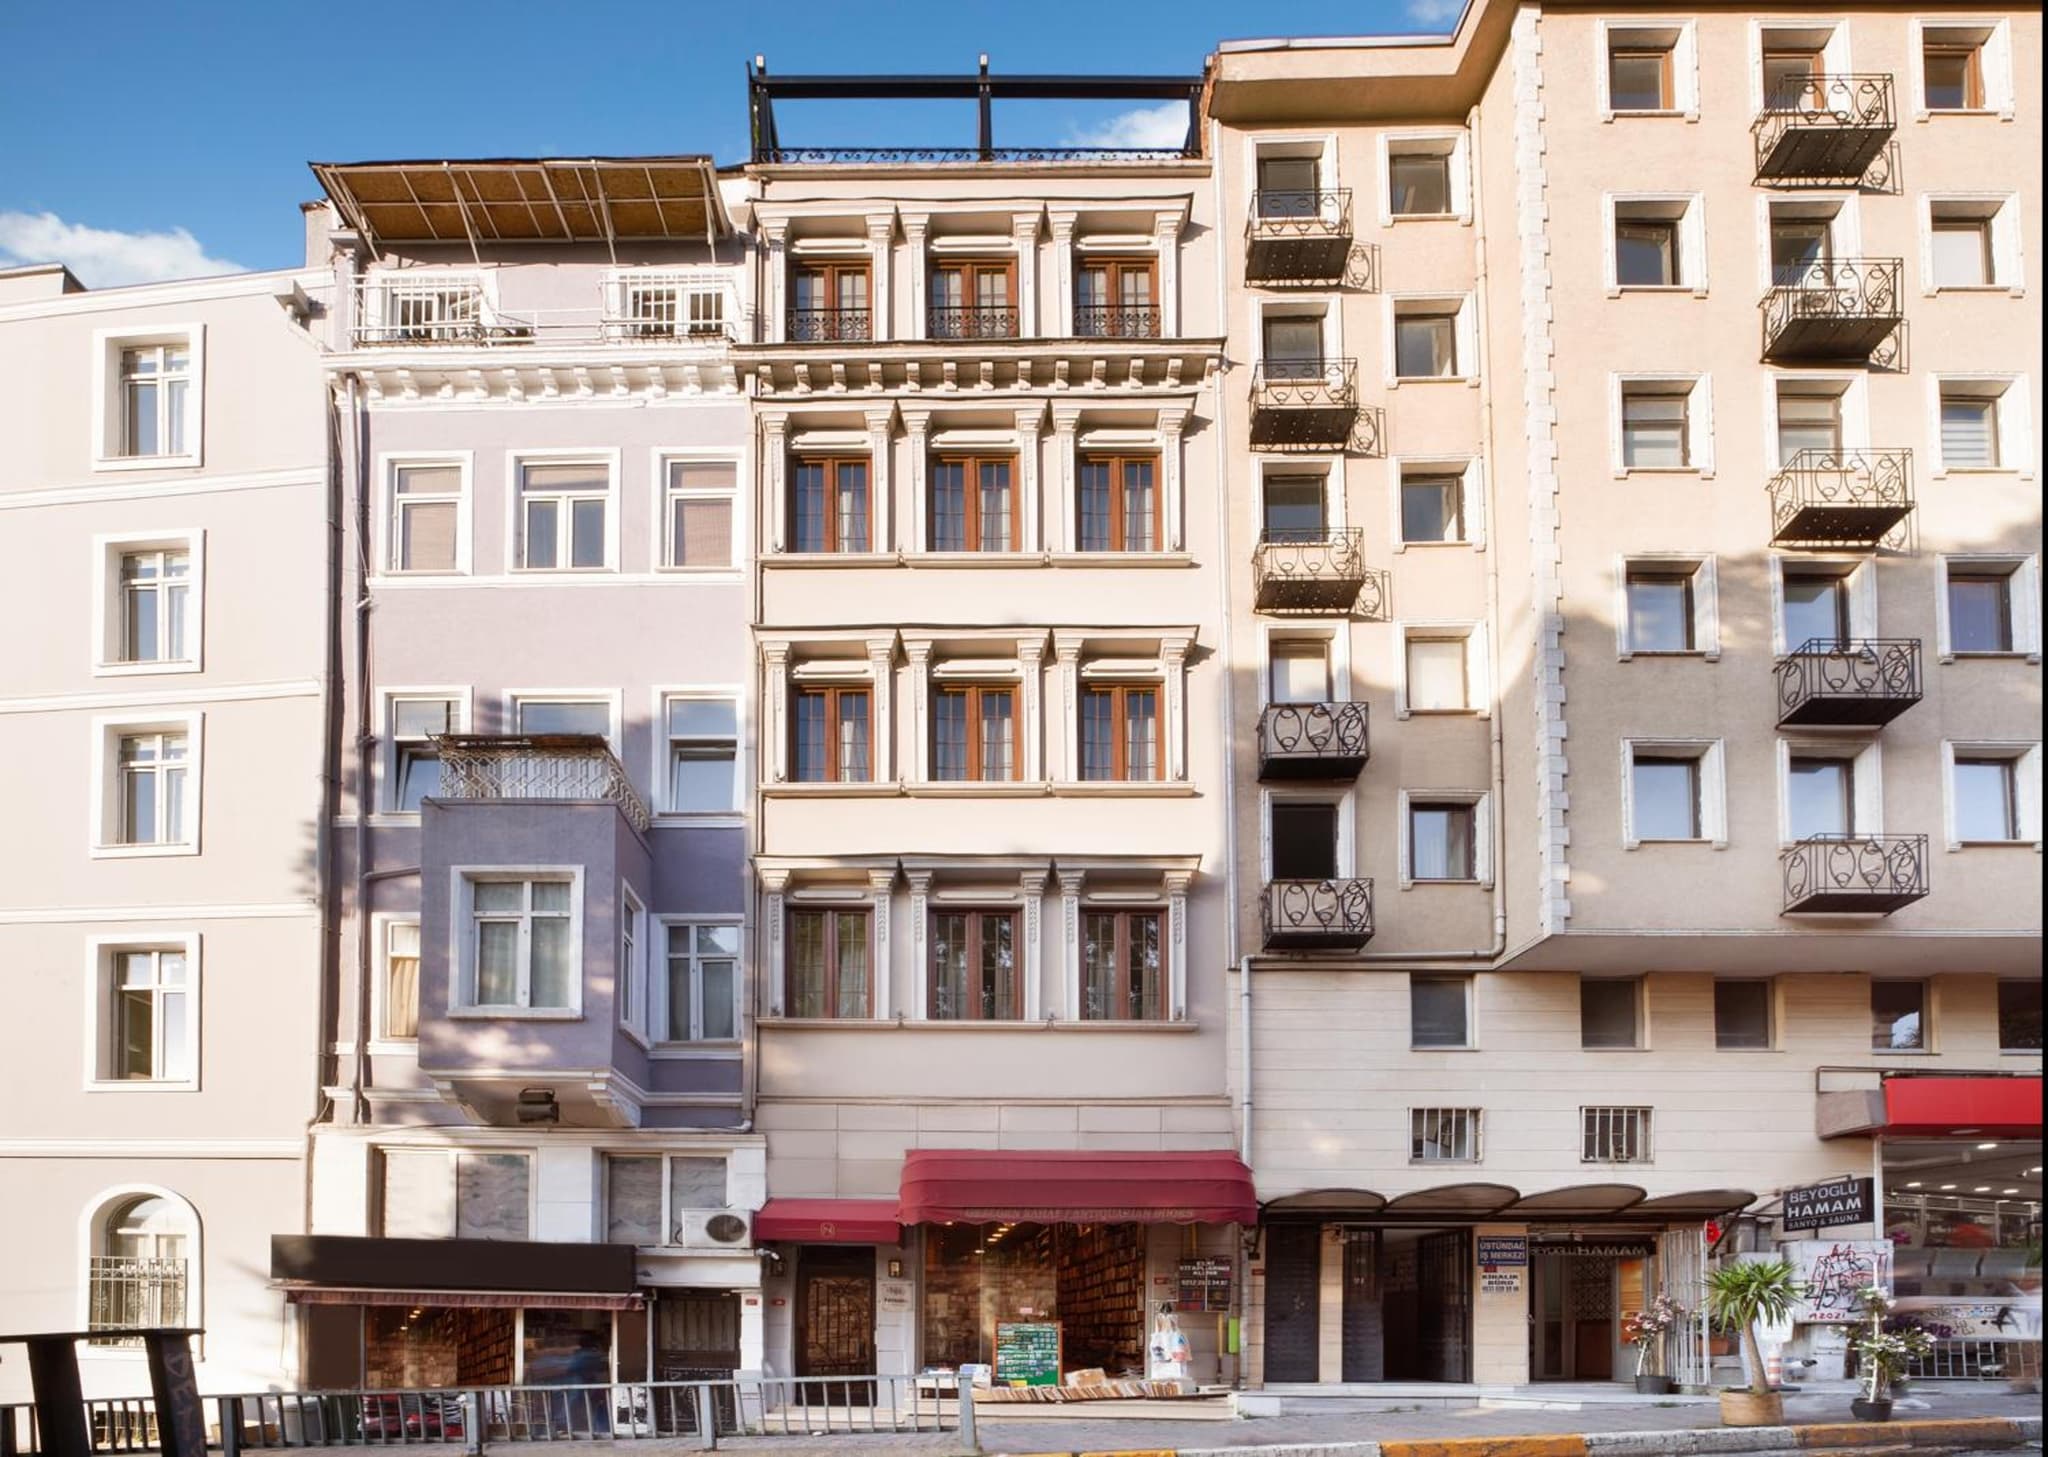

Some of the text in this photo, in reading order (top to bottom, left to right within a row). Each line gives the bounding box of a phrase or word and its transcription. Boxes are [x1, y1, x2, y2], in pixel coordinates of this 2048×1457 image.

[1787, 1197, 1862, 1218] HAMAM
[1828, 1214, 1861, 1225] SAUNA
[1577, 1246, 1648, 1256] HAMAM
